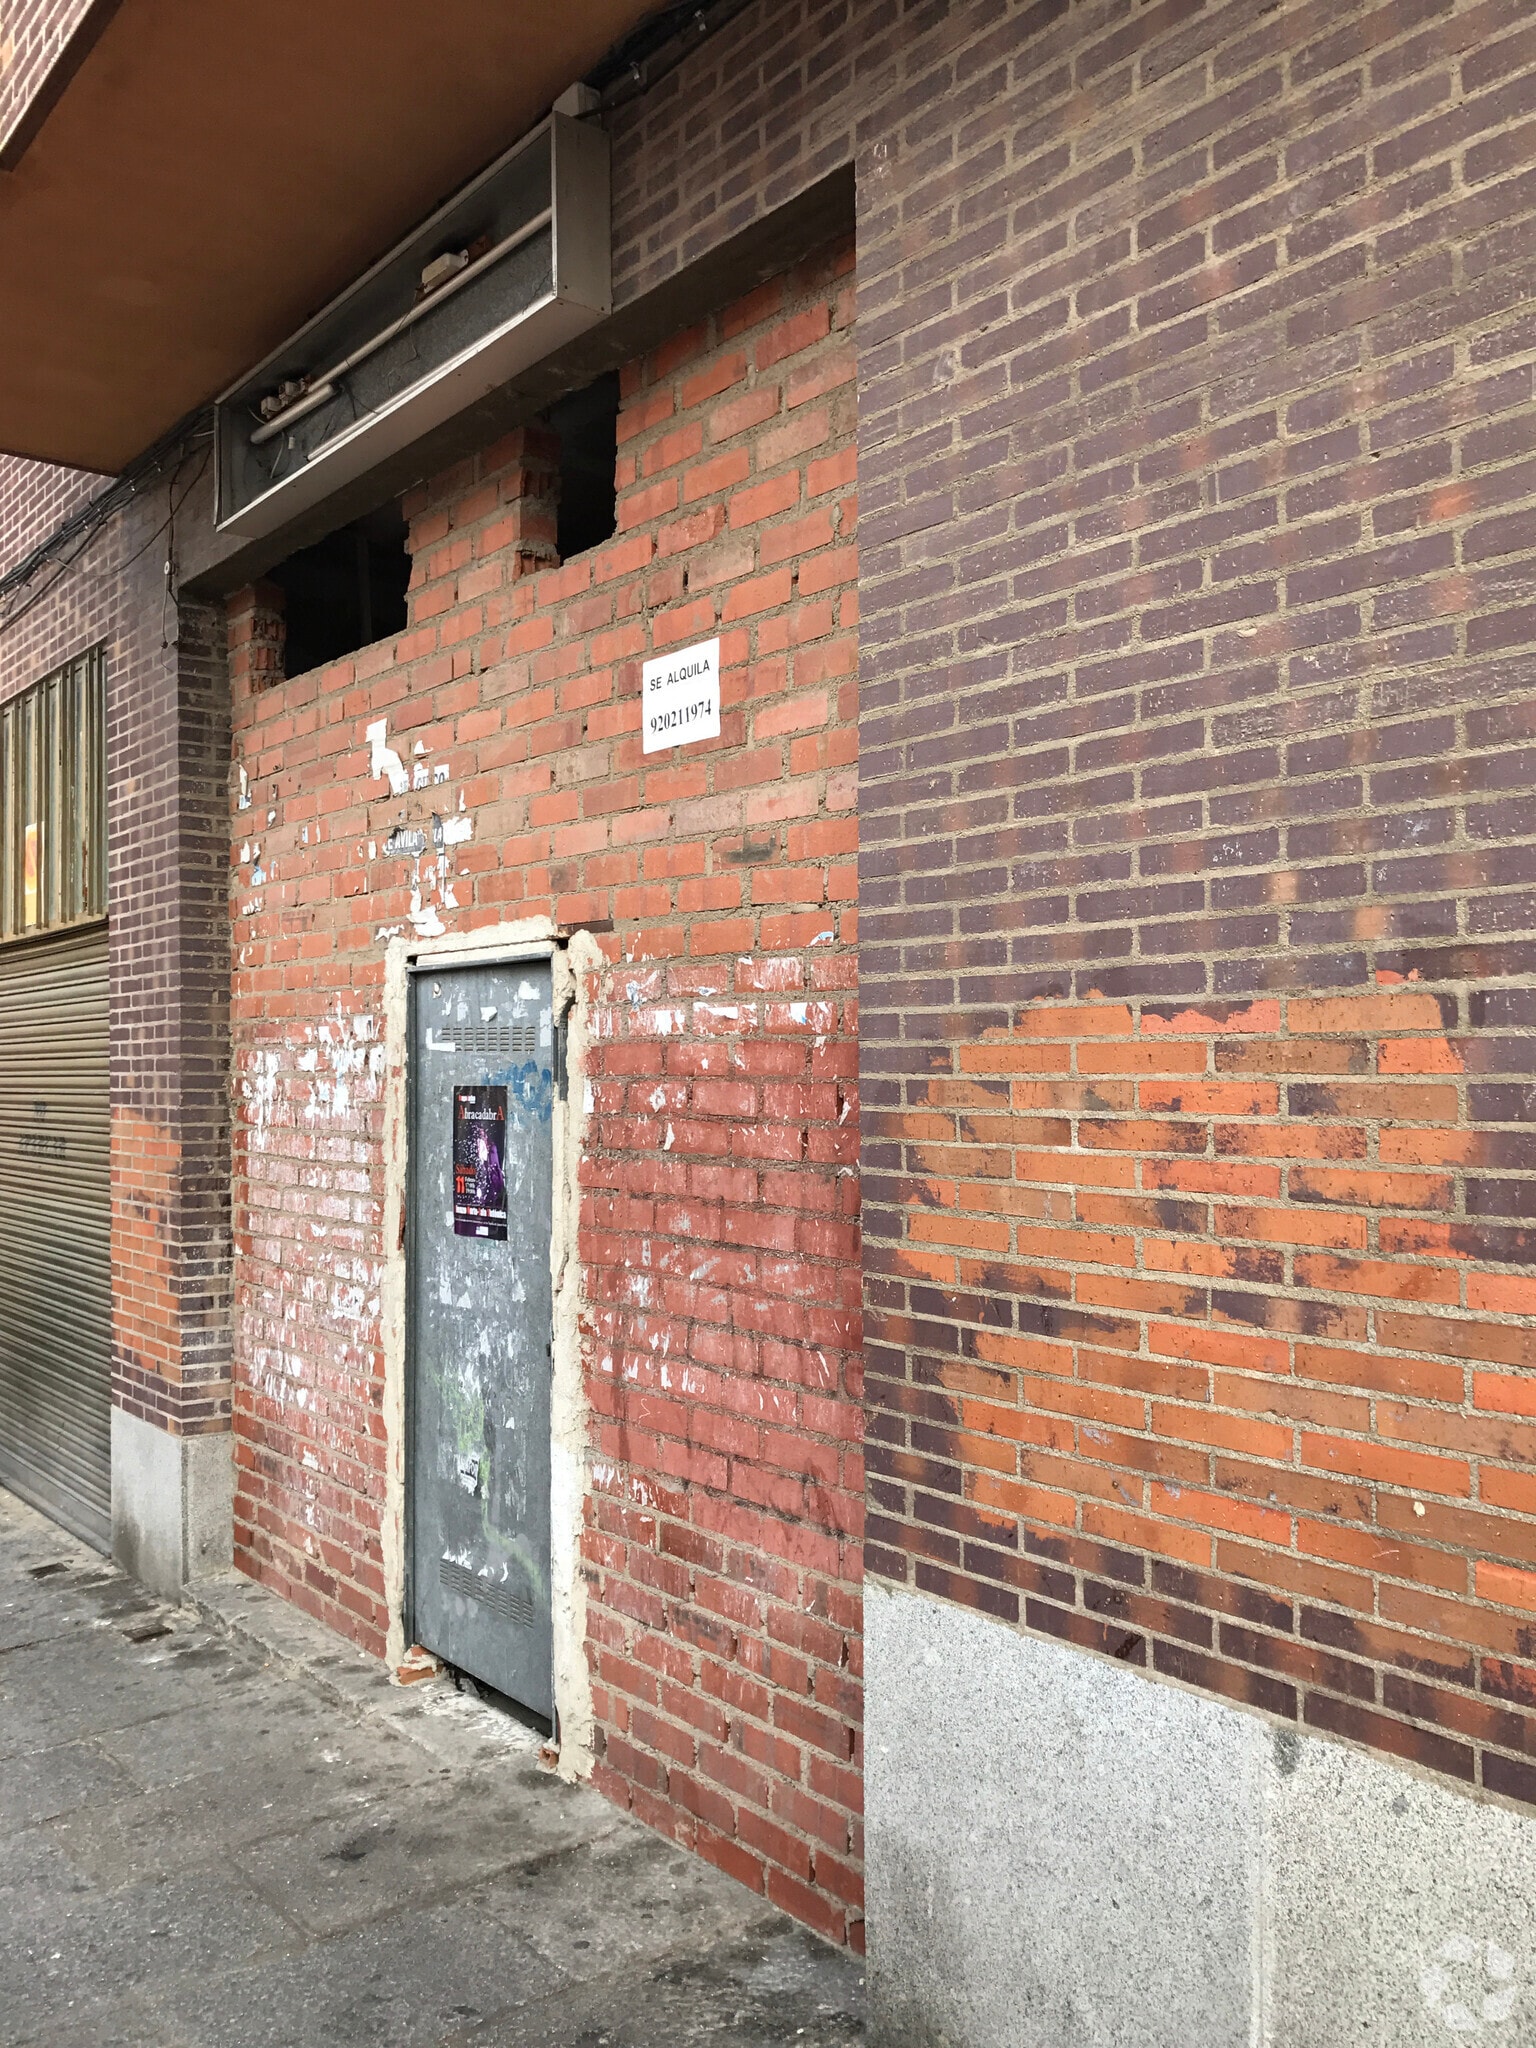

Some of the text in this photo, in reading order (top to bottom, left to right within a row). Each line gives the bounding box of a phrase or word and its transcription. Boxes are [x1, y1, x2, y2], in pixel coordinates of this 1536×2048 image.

[650, 659, 711, 692] SE ALQUILA
[650, 698, 711, 735] 920211974
[458, 1105, 505, 1120] AbracadabrA
[455, 1176, 465, 1194] 11
